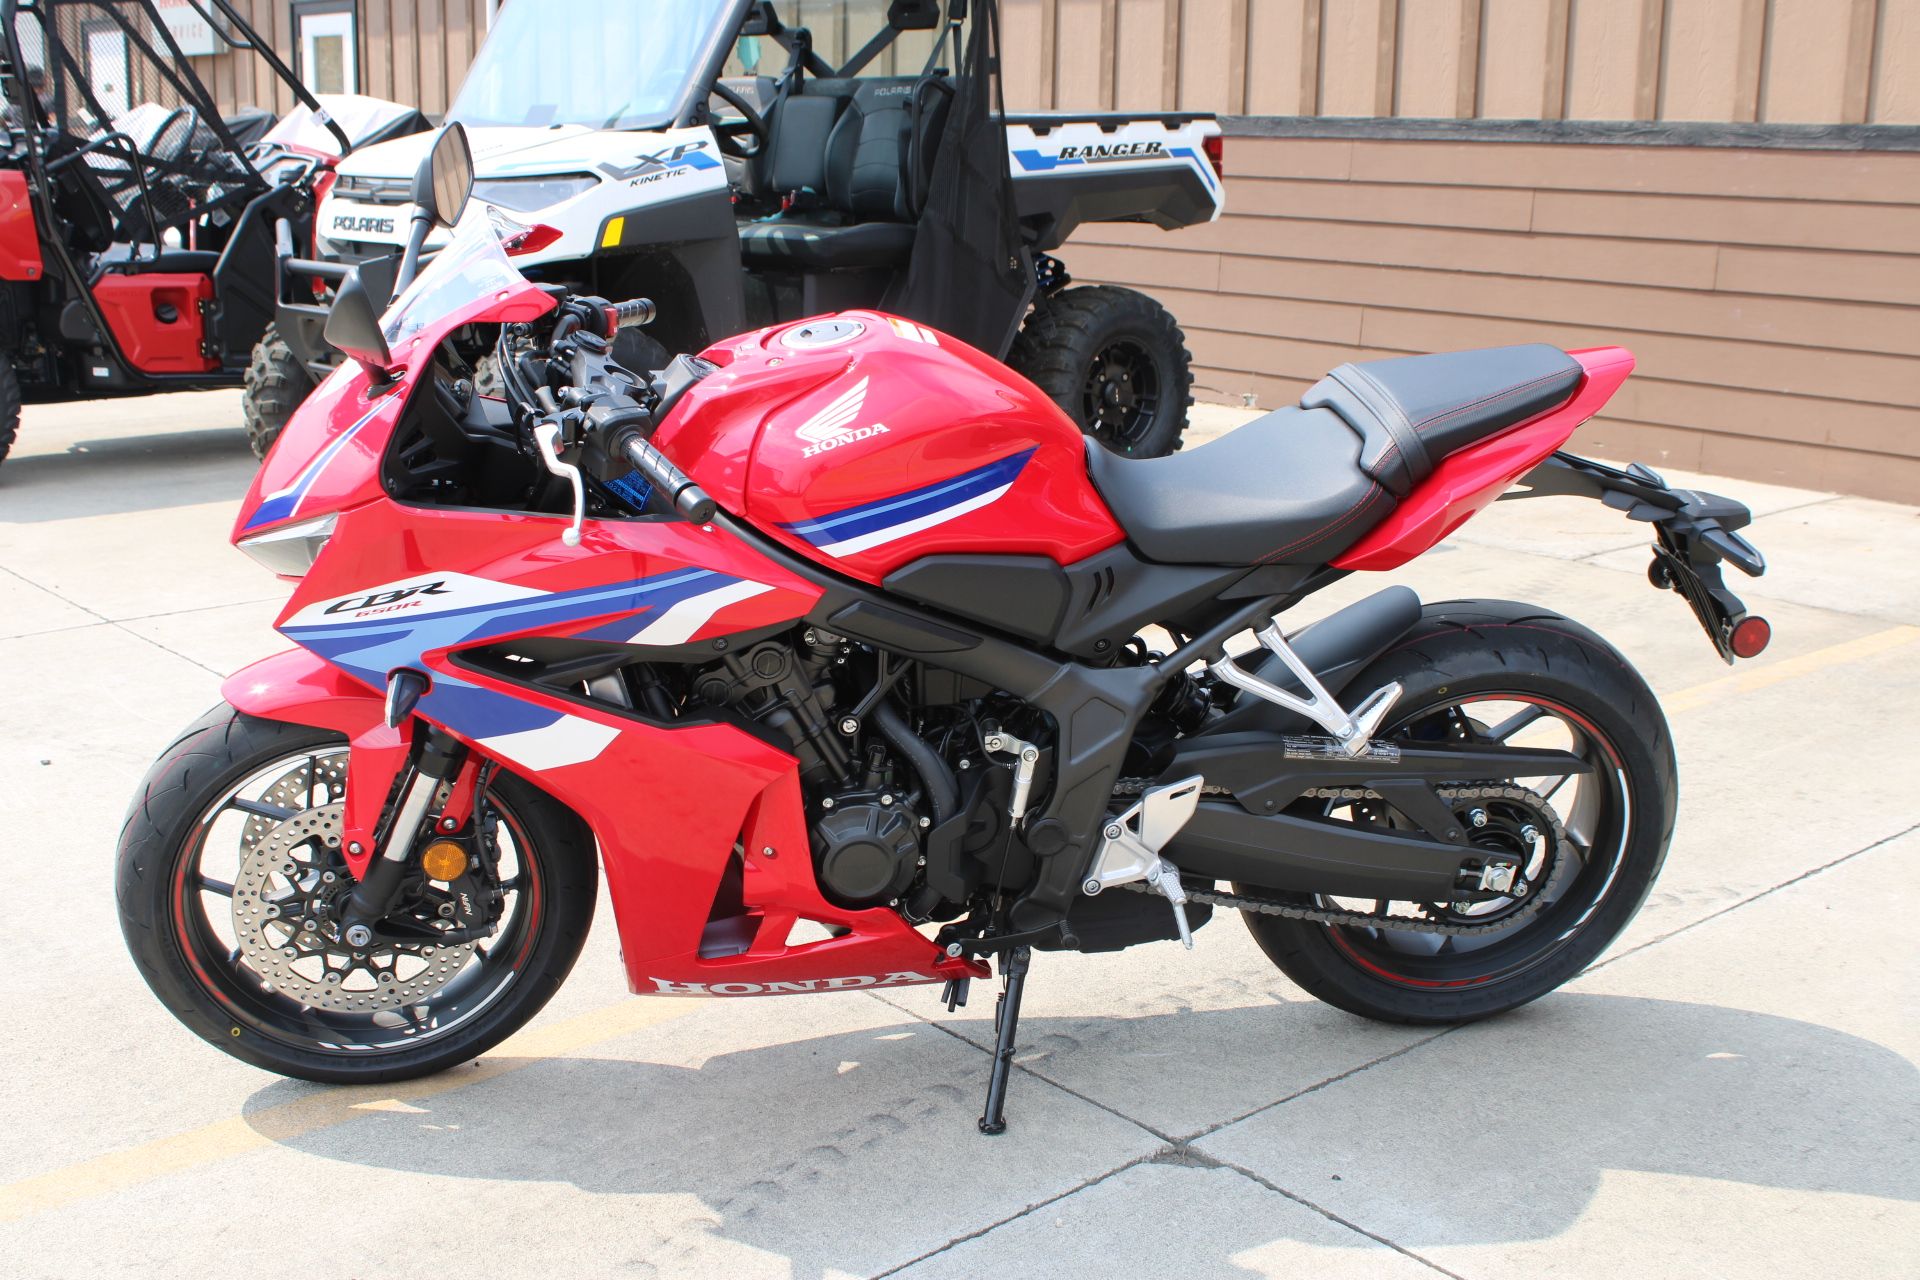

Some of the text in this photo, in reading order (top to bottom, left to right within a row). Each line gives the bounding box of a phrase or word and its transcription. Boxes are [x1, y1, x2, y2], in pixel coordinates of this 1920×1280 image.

[873, 86, 912, 96] POLARIS
[1059, 141, 1162, 159] RANGER
[629, 167, 688, 187] KINETIC
[333, 216, 395, 234] POLARIS
[801, 423, 890, 458] HONDA
[323, 581, 454, 615] CBR
[355, 600, 424, 618] 650R
[649, 971, 937, 994] HONDA
